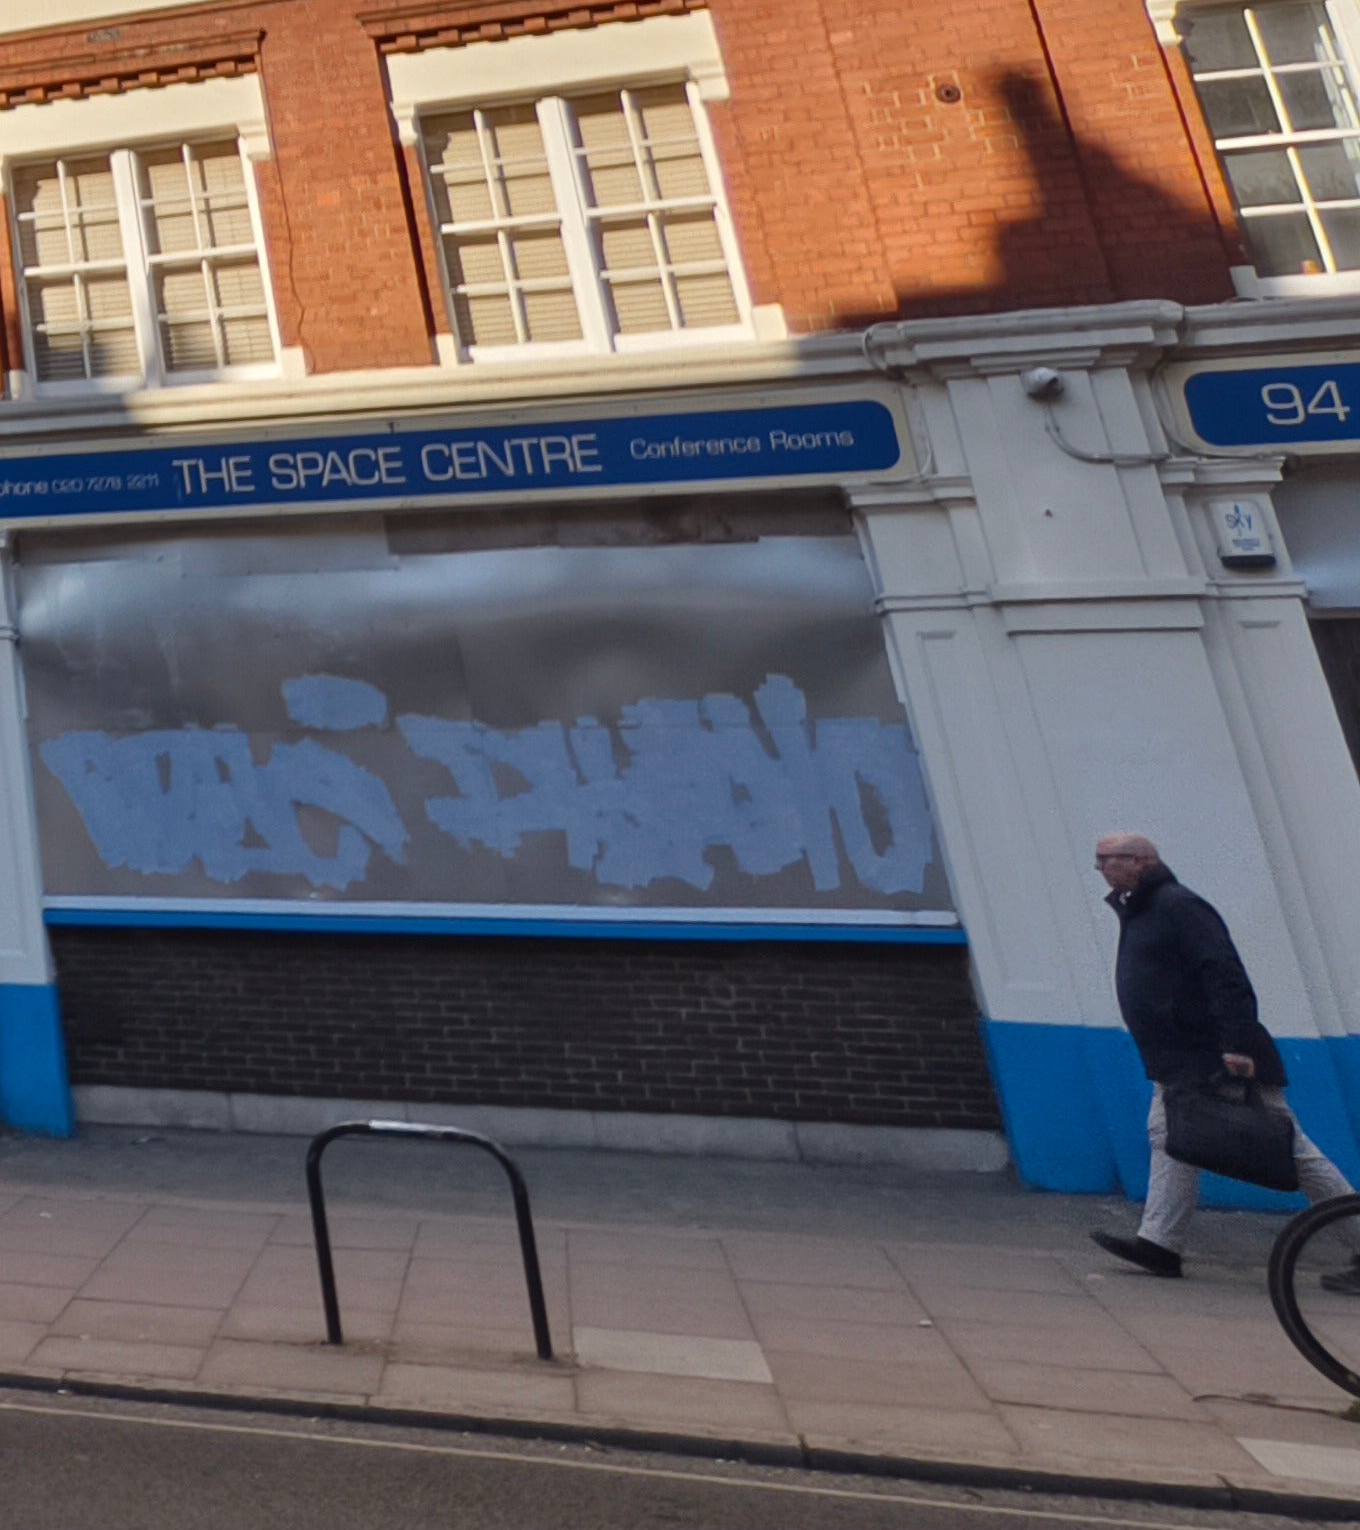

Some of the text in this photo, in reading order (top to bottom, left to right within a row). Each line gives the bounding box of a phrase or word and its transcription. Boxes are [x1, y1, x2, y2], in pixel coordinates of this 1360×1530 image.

[1261, 381, 1350, 425] 94
[52, 477, 83, 493] 020
[173, 456, 255, 494] THE
[269, 447, 406, 490] SPACE
[421, 434, 603, 482] CENTRE
[630, 436, 760, 460] Conference
[769, 429, 854, 451] Rooms
